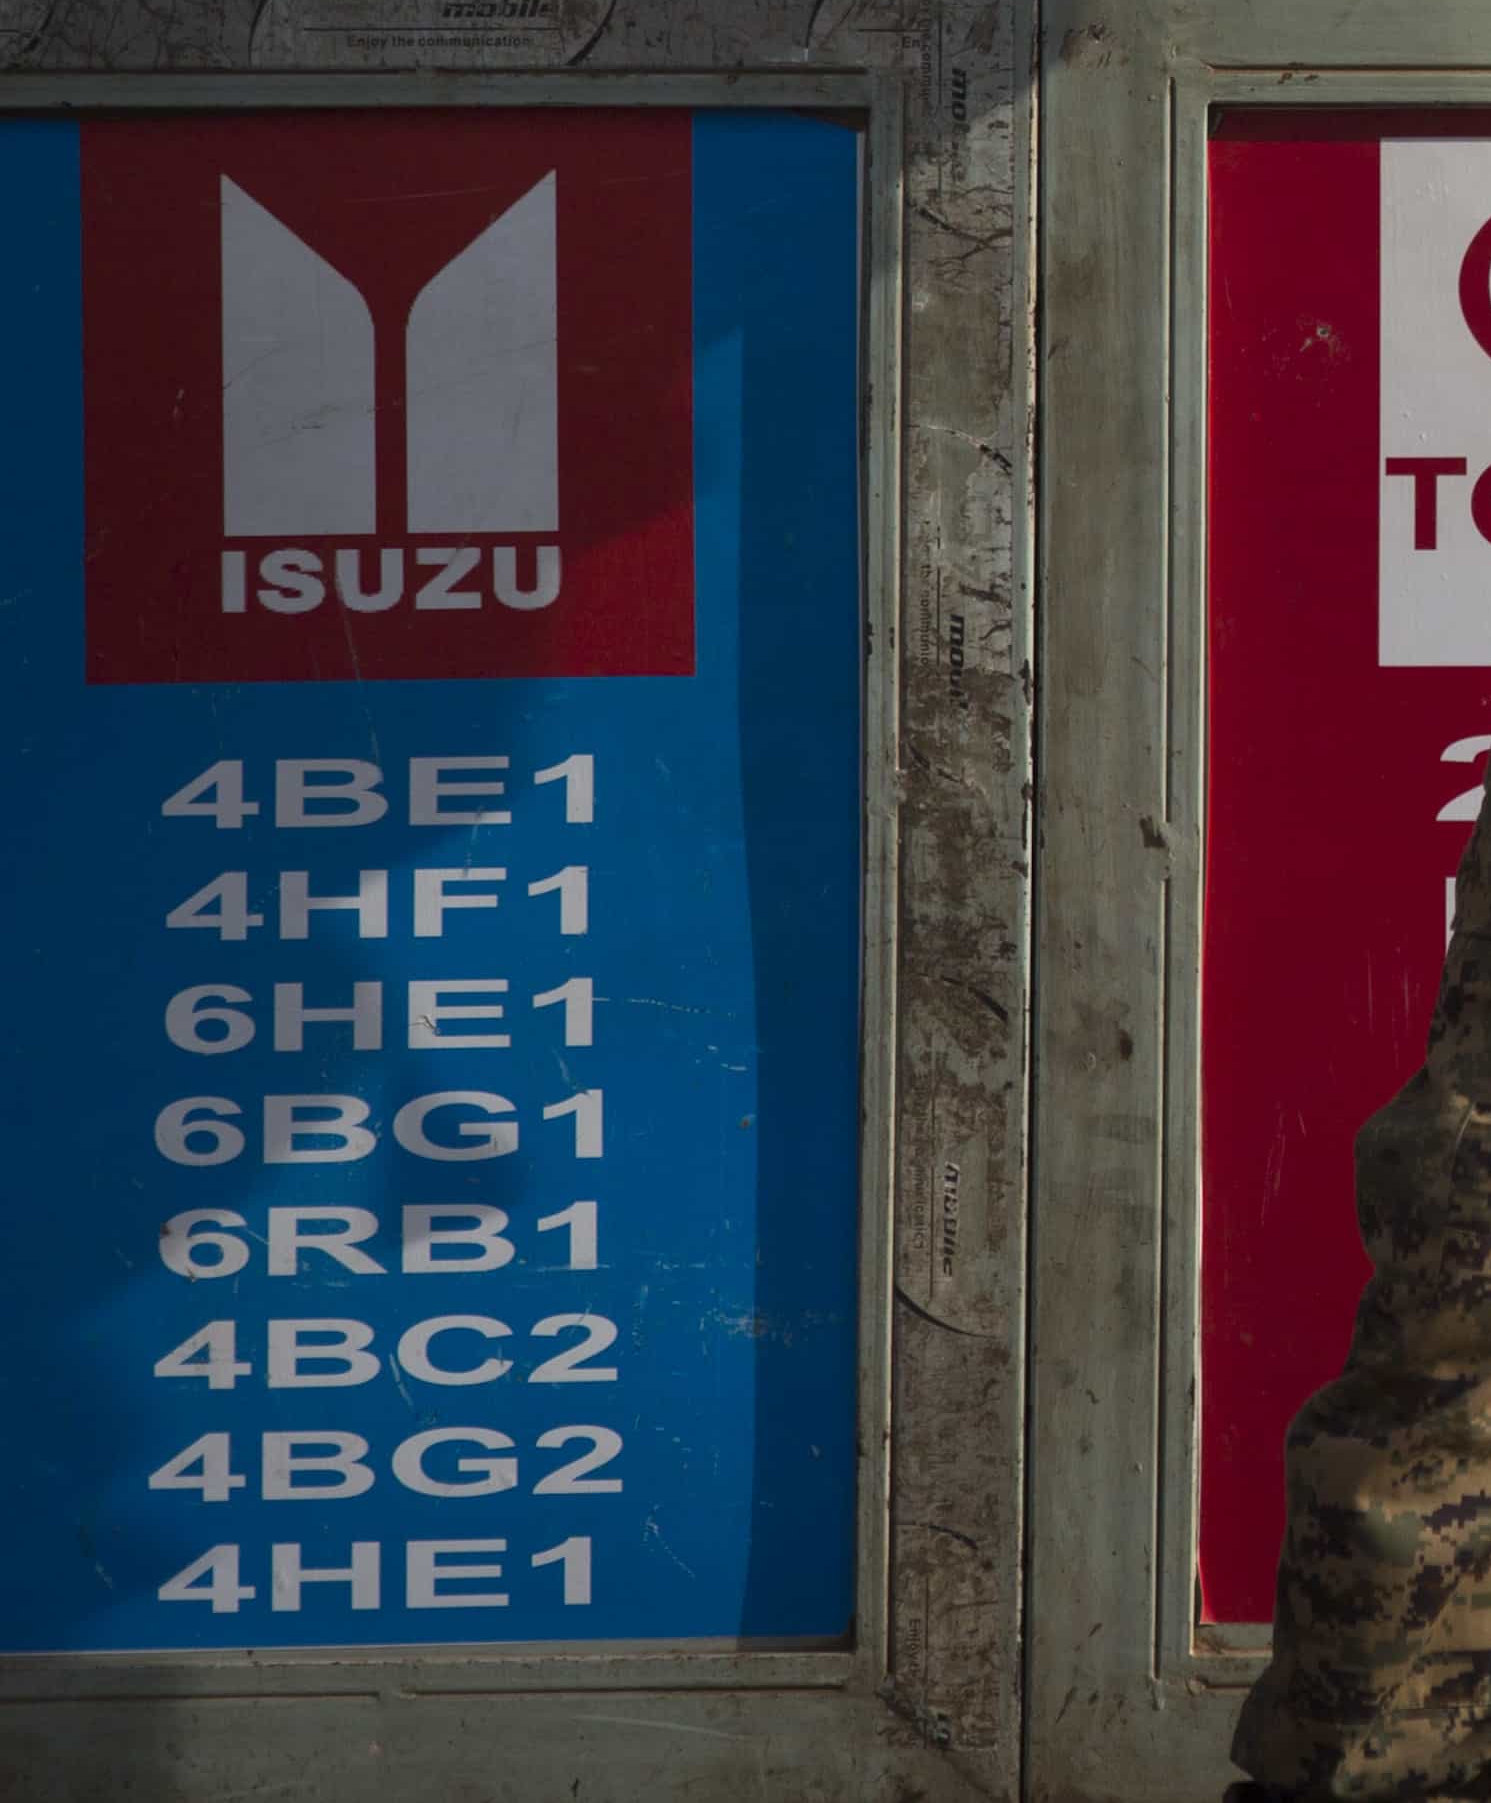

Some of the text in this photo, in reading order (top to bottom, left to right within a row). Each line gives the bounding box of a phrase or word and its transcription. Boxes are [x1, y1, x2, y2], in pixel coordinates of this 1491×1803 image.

[391, 35, 414, 48] the
[221, 546, 562, 614] ISUZU
[162, 753, 595, 829] 4BE1
[166, 865, 589, 941] 4HF1
[164, 977, 595, 1054] 6HE1
[154, 1089, 604, 1166] 6BG1
[158, 1201, 598, 1281] 6RB1
[153, 1312, 619, 1390] 4BC2
[148, 1424, 624, 1502] 4BG2
[157, 1535, 593, 1614] 4HE1
